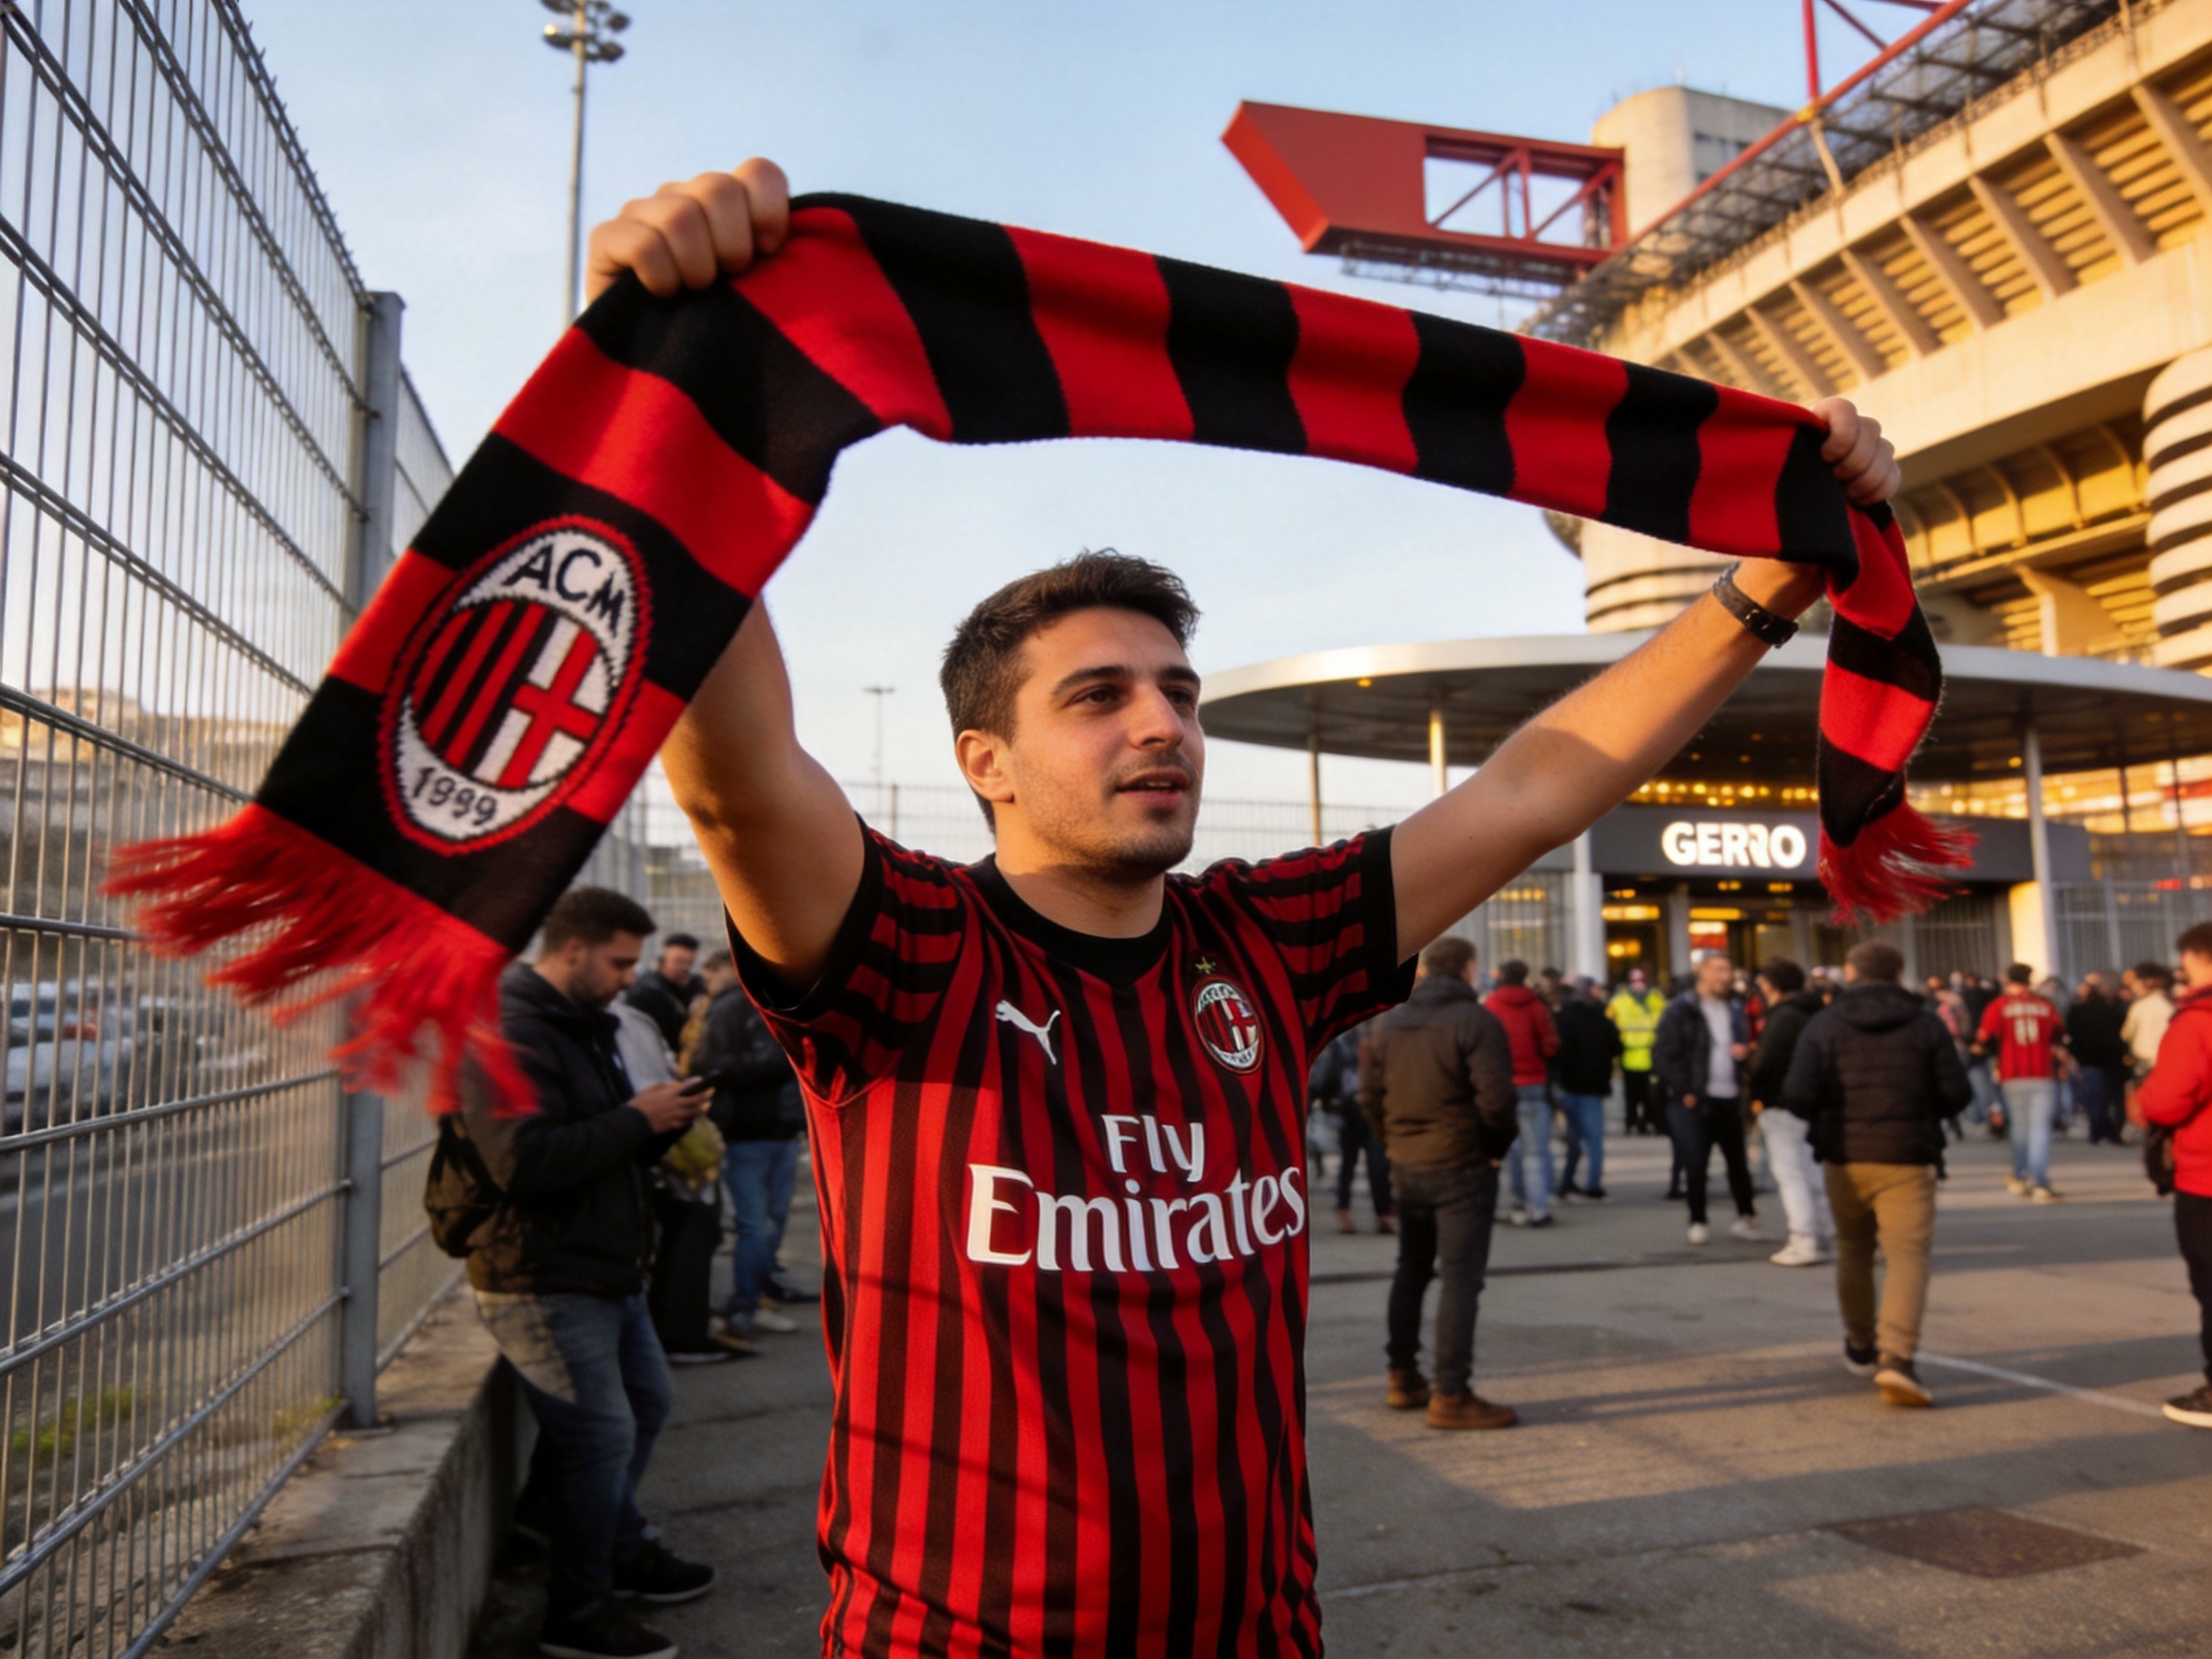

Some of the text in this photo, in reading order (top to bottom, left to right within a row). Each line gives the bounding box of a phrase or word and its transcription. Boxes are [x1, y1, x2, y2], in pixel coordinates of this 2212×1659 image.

[500, 543, 625, 637] ACM
[1101, 1114, 1204, 1183] Fly
[966, 1163, 1305, 1272] Emirates
